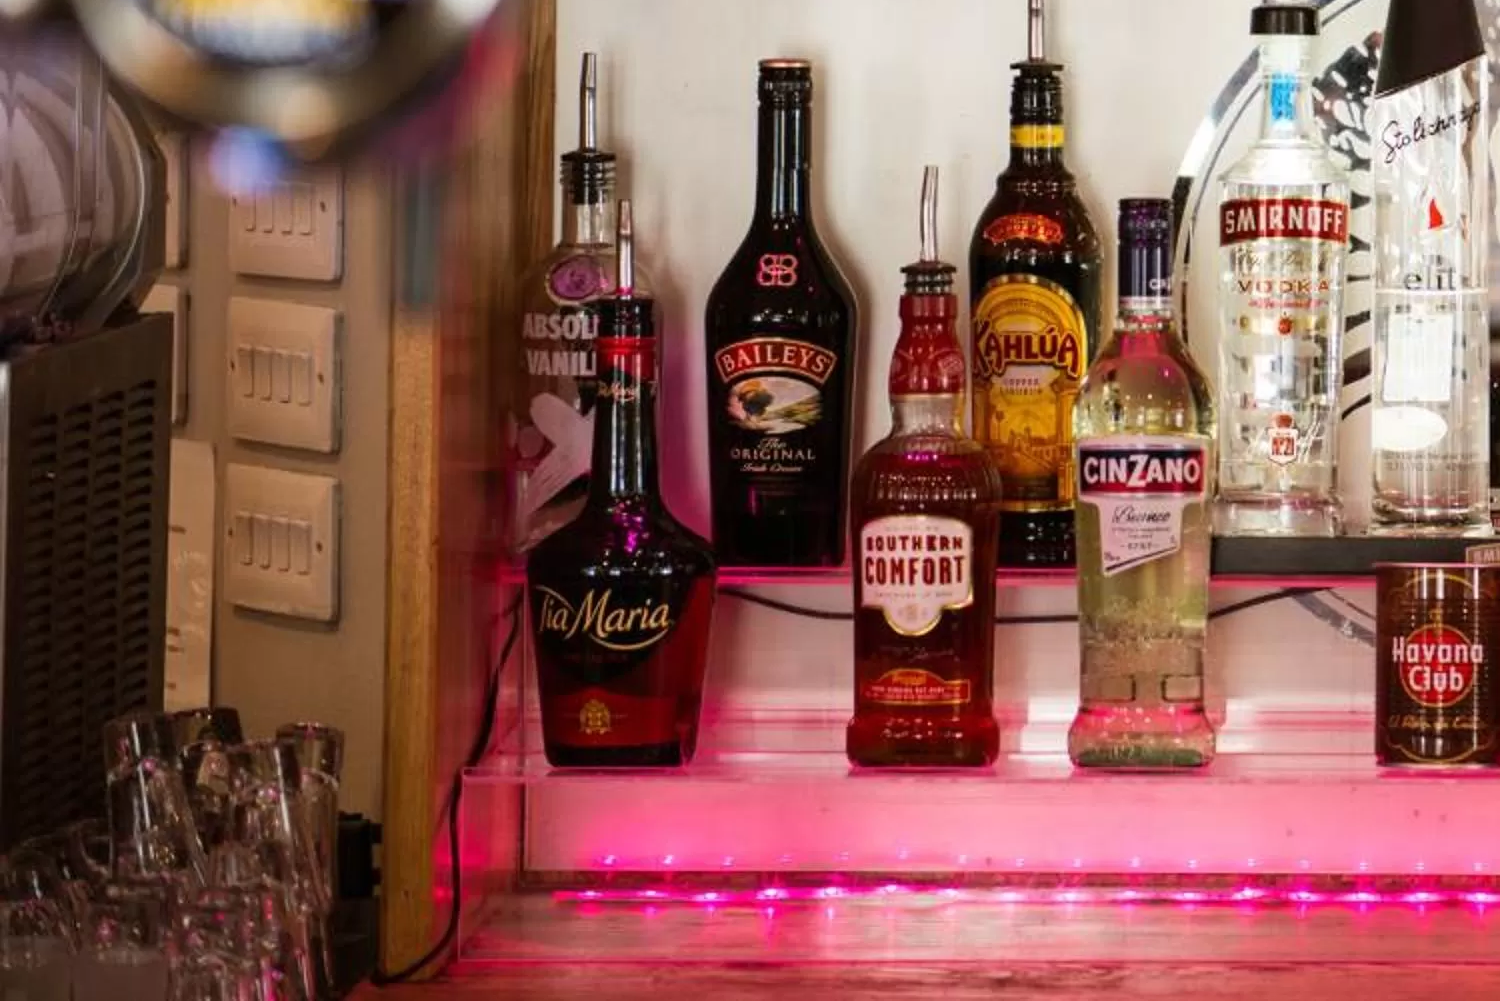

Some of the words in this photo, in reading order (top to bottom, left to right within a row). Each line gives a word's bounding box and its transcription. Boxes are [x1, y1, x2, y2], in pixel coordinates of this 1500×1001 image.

[1224, 205, 1343, 235] SMIRNOFF
[1236, 279, 1330, 294] VODKA
[721, 344, 826, 373] BAILEYS
[970, 324, 1080, 380] KAHLÚA
[730, 448, 817, 462] ORIGINAL
[1082, 453, 1201, 488] CINZANO
[865, 534, 963, 553] SOUTHERN
[864, 556, 965, 586] COMFORT
[564, 587, 671, 641] Maria
[1392, 635, 1484, 664] Havana
[1408, 665, 1464, 692] Club
